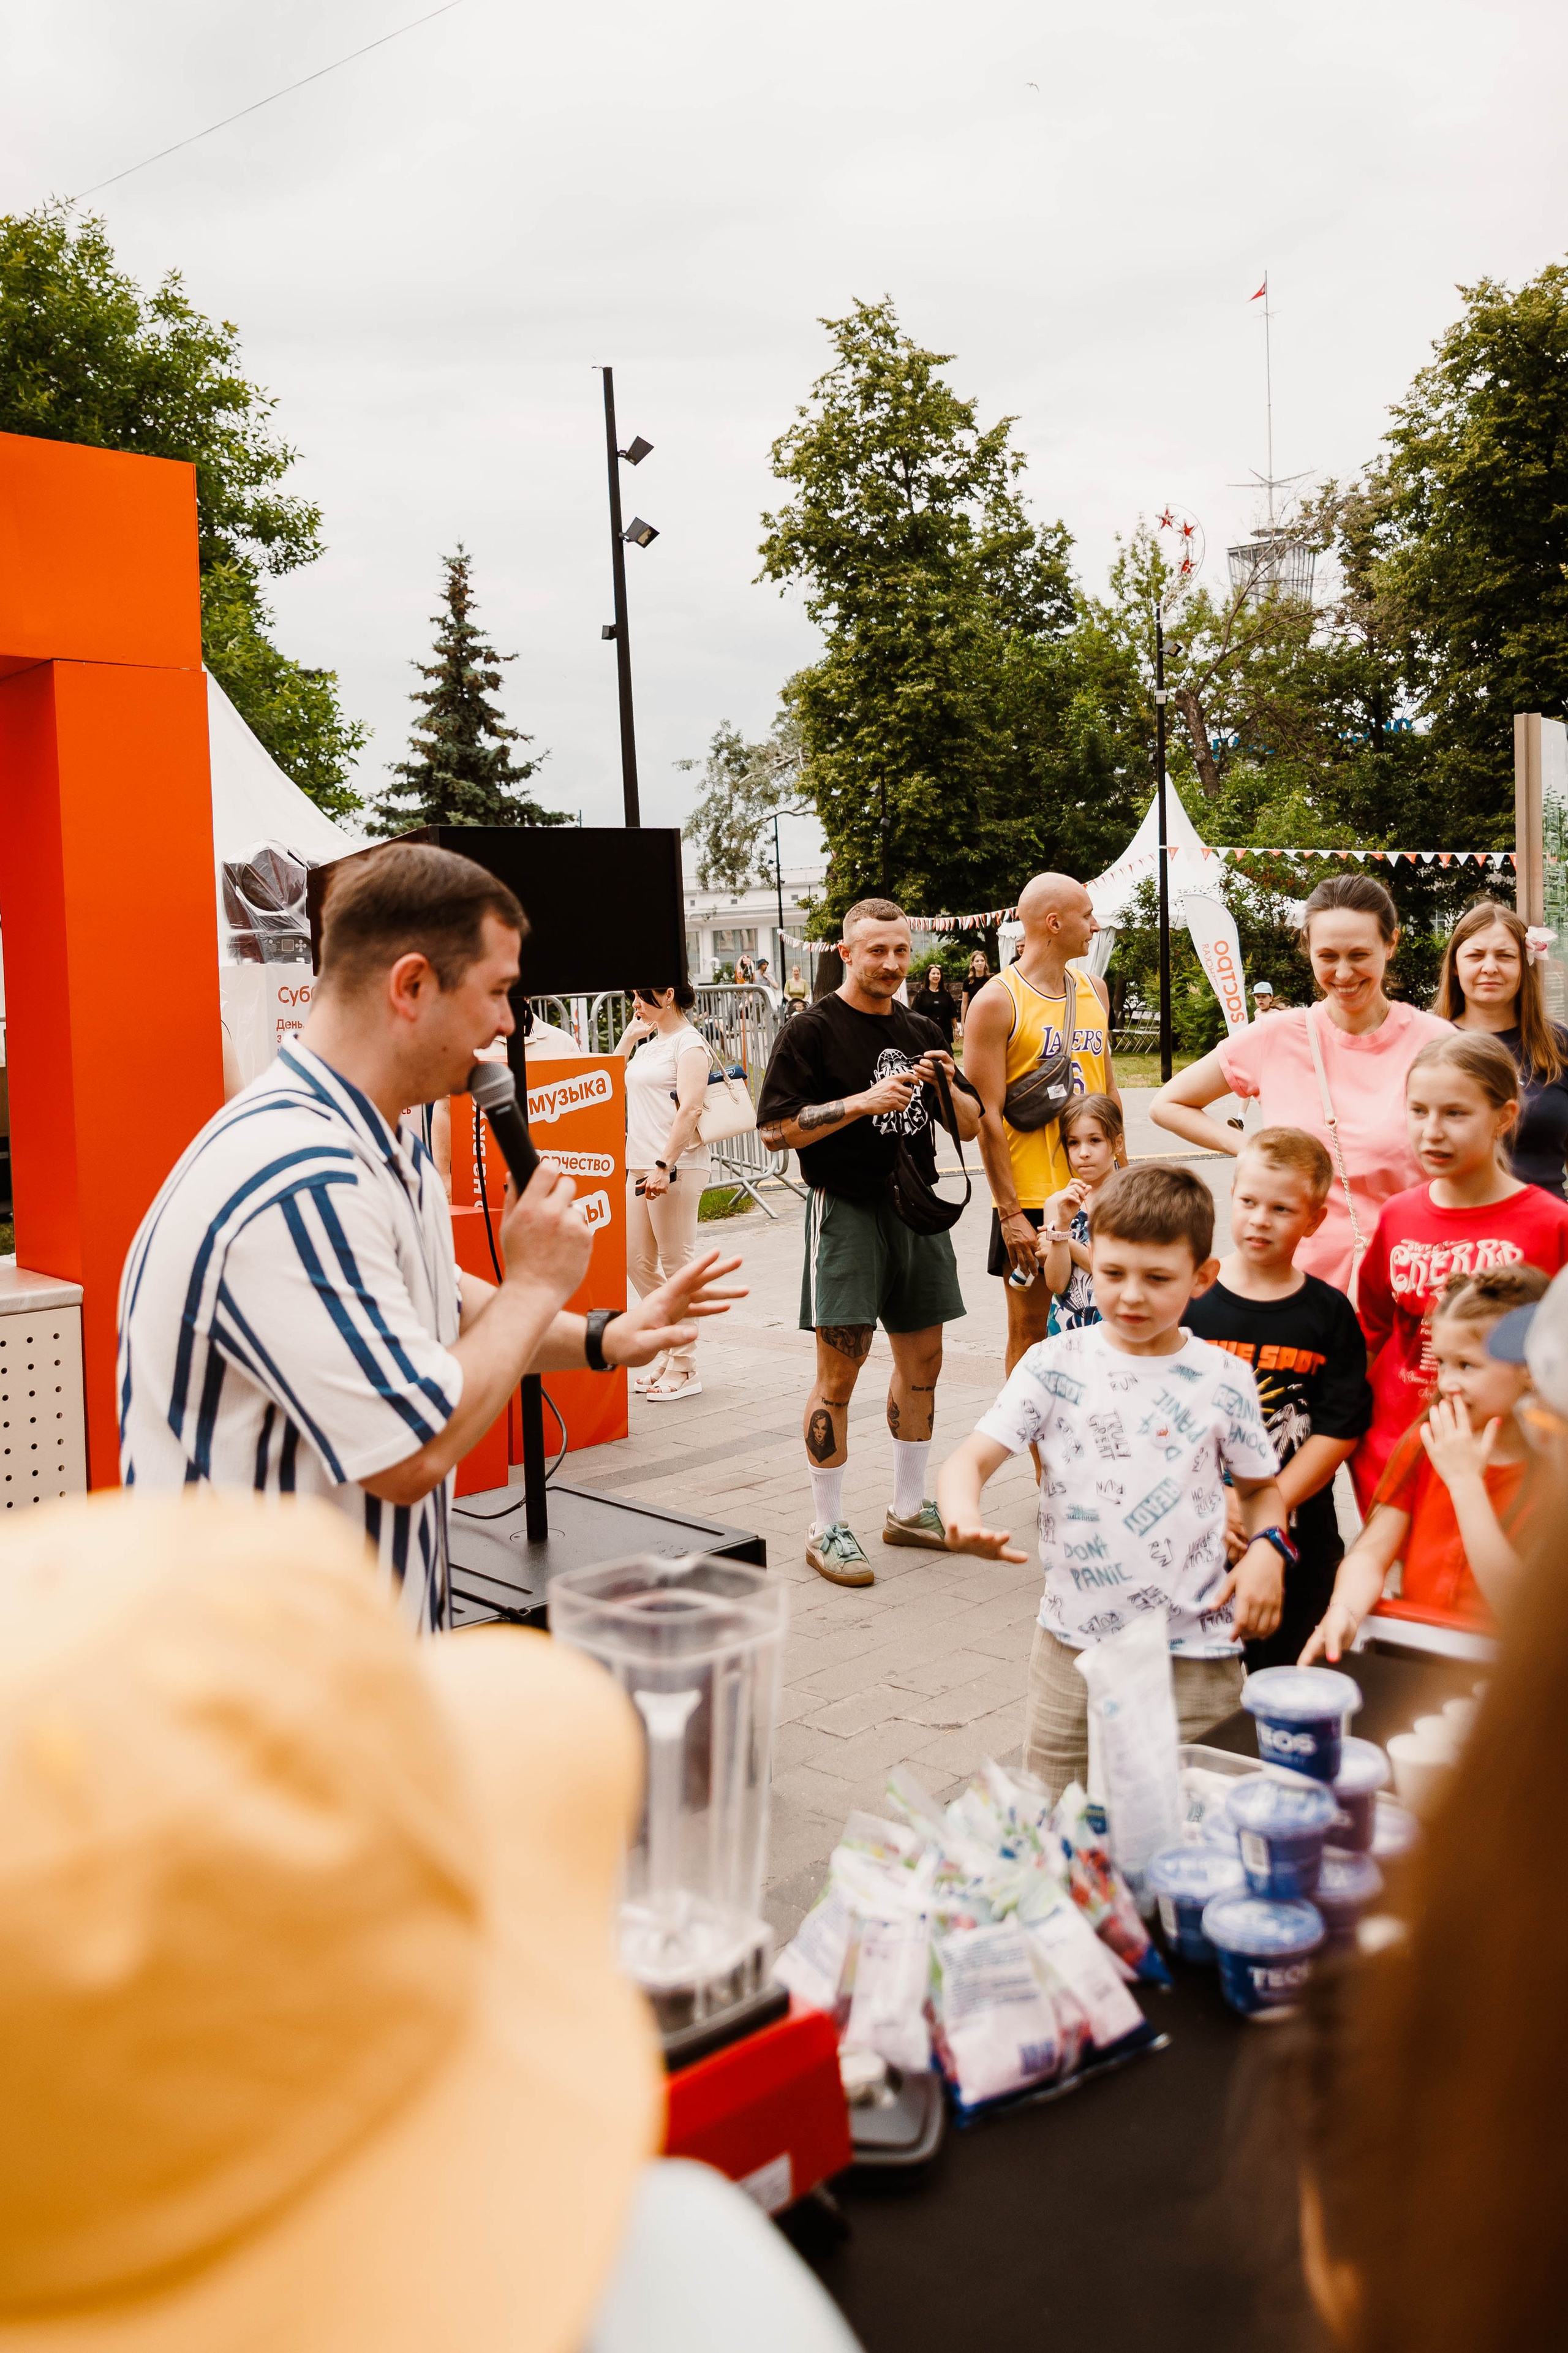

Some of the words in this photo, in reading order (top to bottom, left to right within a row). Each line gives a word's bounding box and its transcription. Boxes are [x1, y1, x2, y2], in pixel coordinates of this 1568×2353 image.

[1036, 1025, 1103, 1060] LAERS
[528, 1077, 607, 1116] музыка
[1257, 1344, 1327, 1377] SPOT
